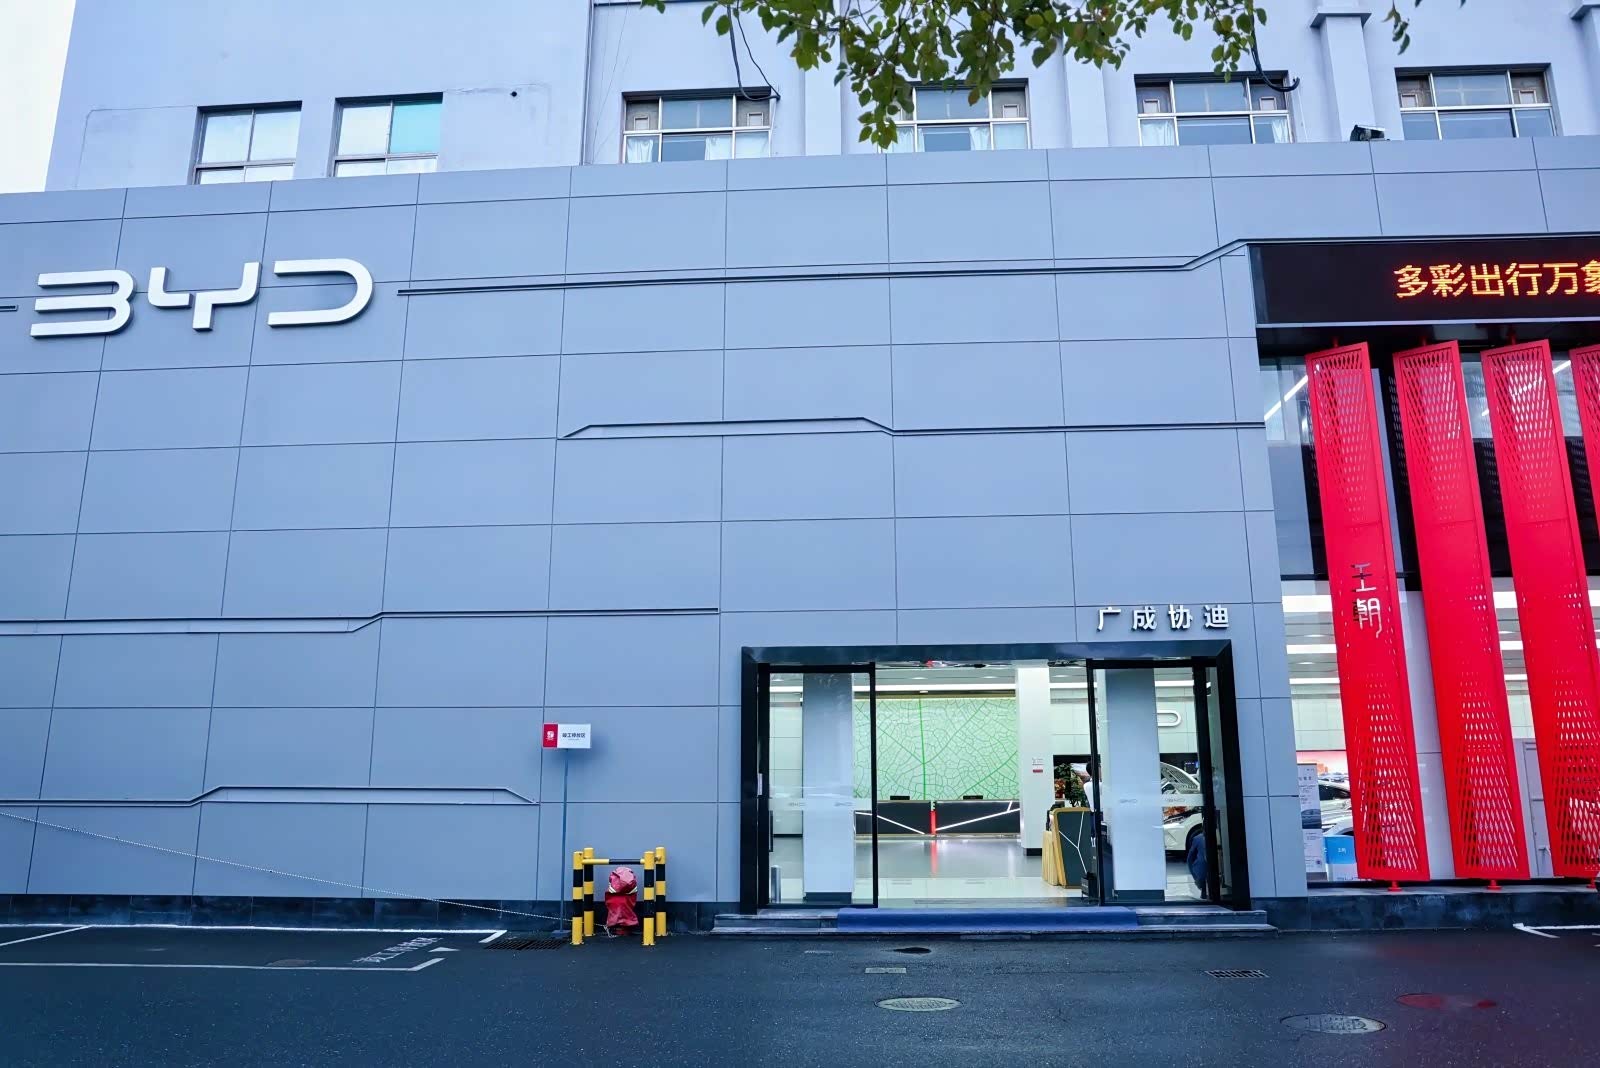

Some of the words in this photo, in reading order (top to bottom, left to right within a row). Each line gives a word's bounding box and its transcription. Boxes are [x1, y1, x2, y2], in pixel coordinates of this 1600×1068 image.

[30, 257, 374, 338] BYD
[1097, 603, 1230, 632] 广成协迪
